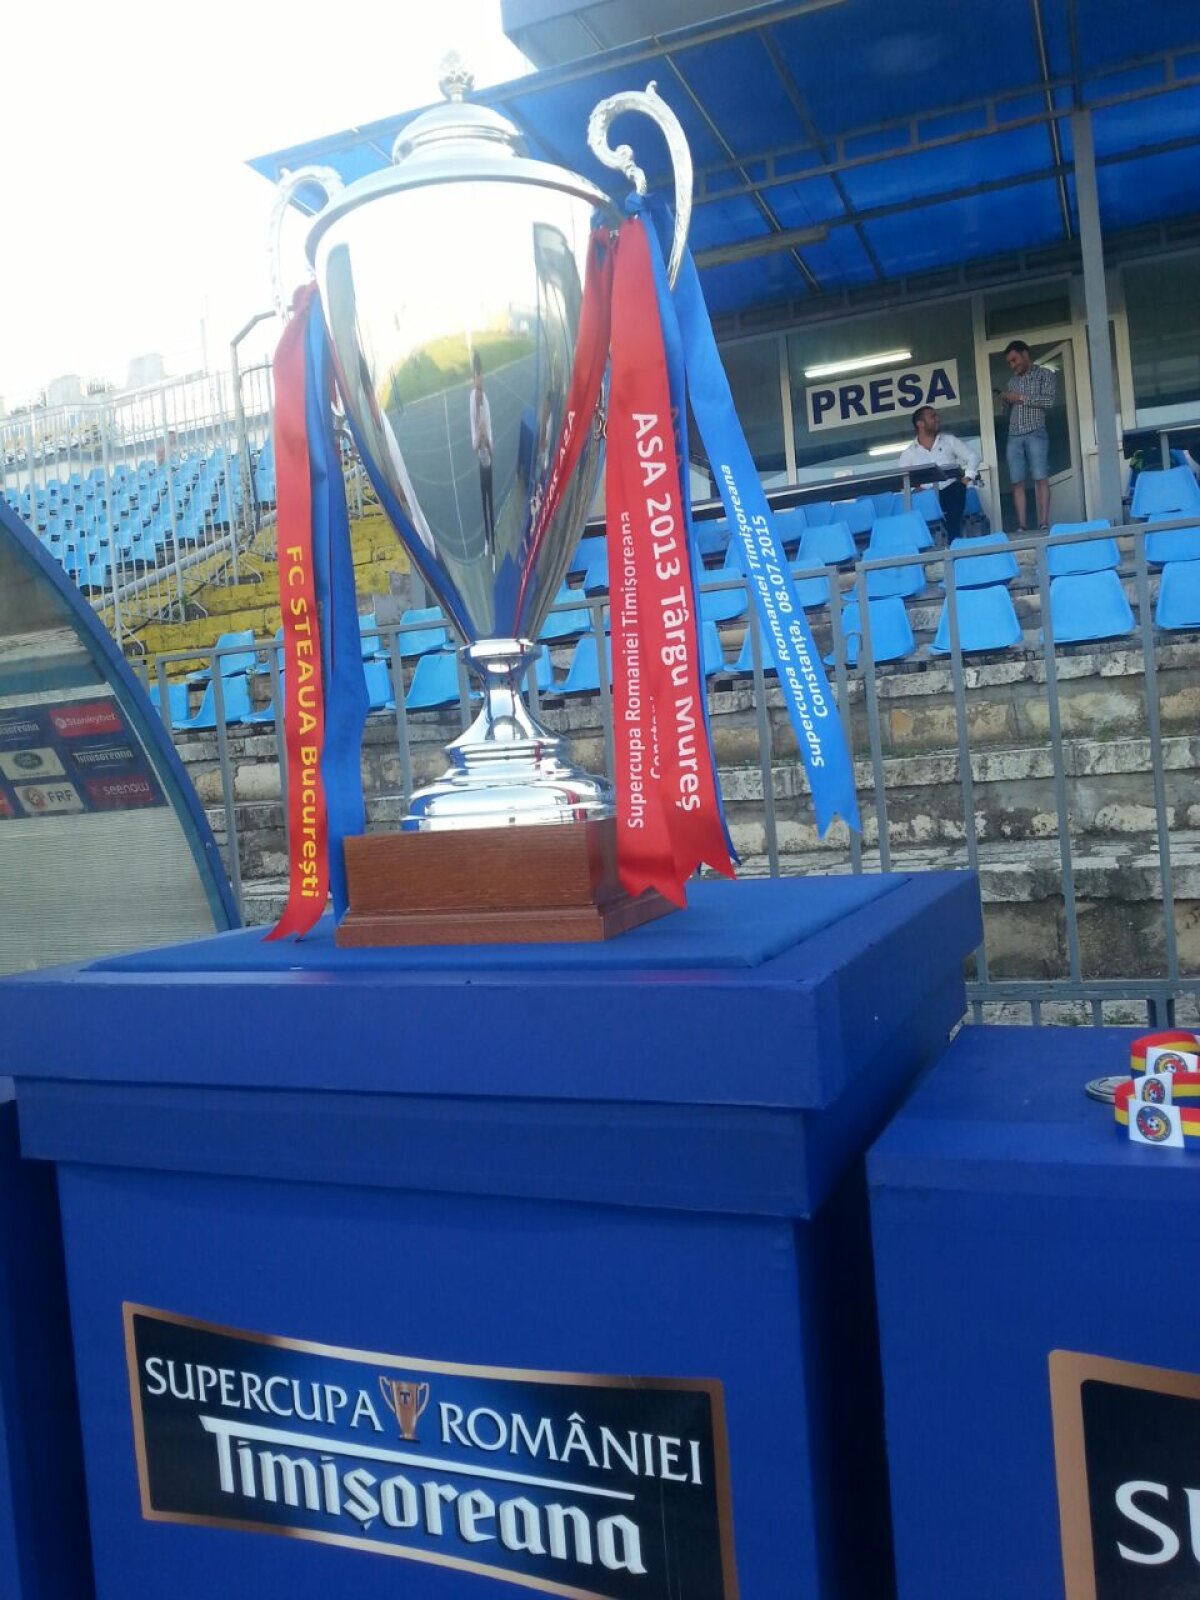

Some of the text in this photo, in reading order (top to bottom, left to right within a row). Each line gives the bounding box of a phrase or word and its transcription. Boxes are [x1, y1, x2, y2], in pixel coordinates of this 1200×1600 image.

[811, 368, 956, 425] PRESA
[632, 413, 667, 487] ASA
[646, 493, 681, 581] 2013
[752, 515, 792, 613] 08.07.2015
[661, 586, 690, 687] Târgu
[721, 464, 824, 767] Supercupa Romaniei Timișoreana
[287, 545, 319, 897] FC STEAUA București
[622, 633, 641, 721] Romaniei
[46, 789, 73, 803] FRF
[628, 728, 646, 829] Supercupa
[675, 695, 700, 811] Mureș
[144, 1356, 703, 1485] SUPERCUPA ROMÂNIEI
[199, 1415, 648, 1575] Timișoreana
